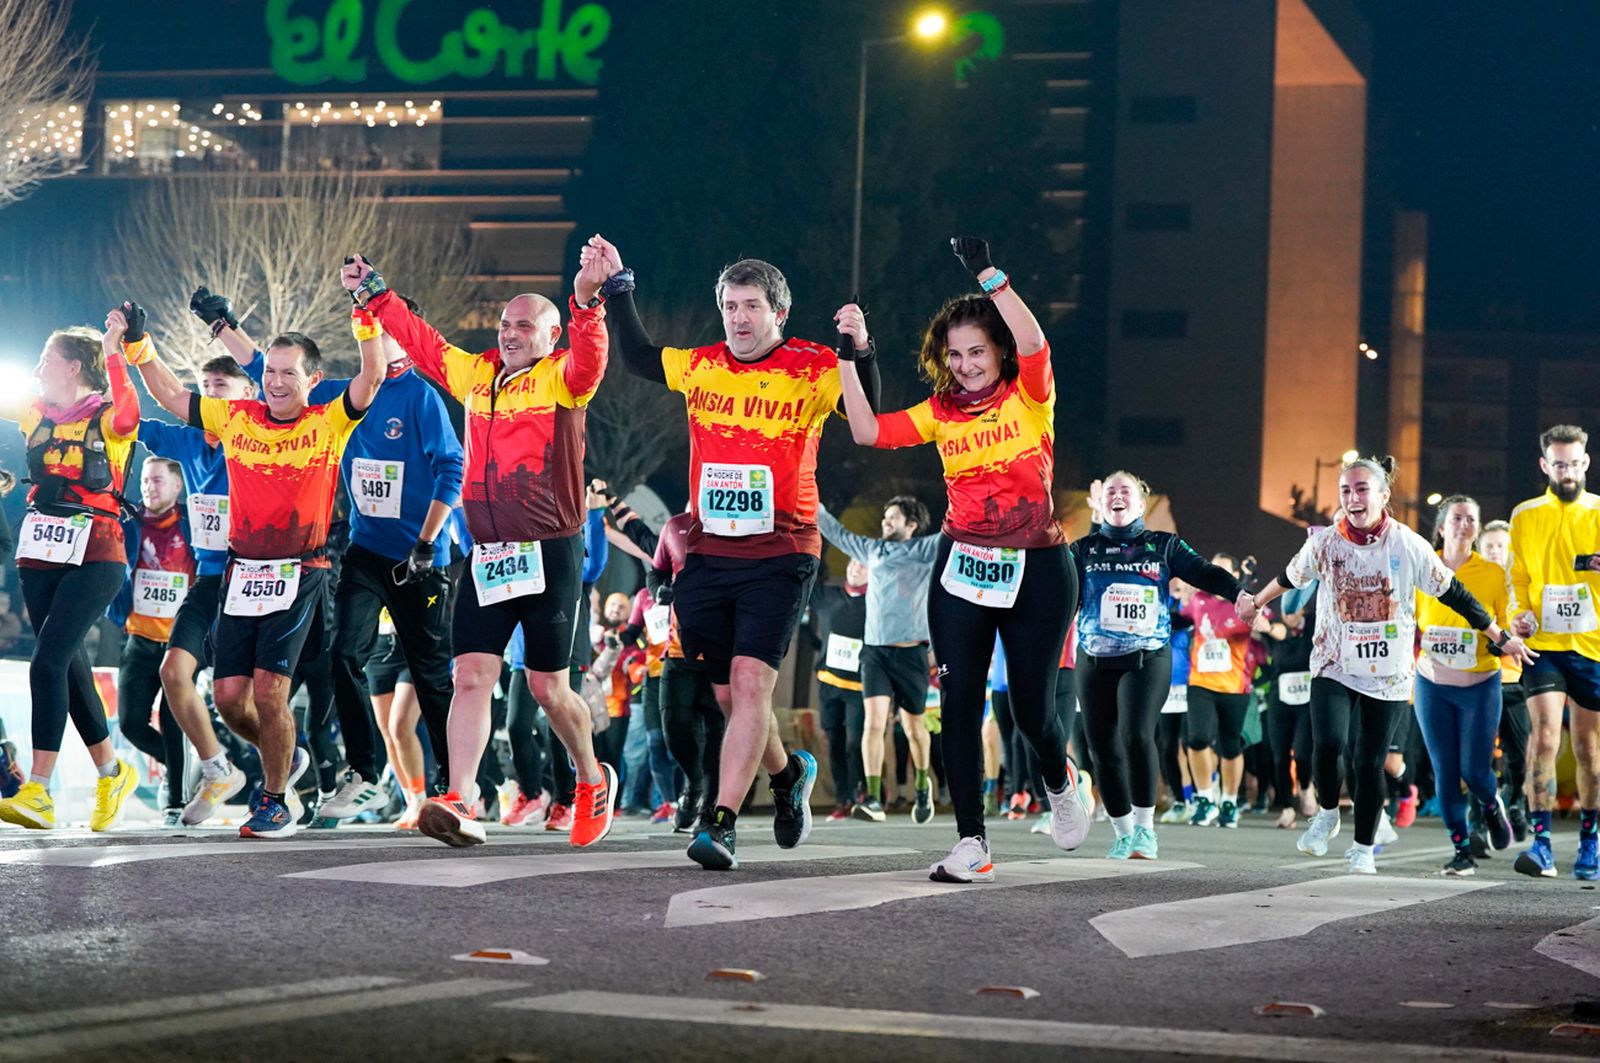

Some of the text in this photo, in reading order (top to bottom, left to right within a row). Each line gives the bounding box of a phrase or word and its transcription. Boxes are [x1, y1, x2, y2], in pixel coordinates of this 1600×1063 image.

[265, 0, 612, 86] El Corte
[744, 396, 805, 424] VIVA!
[973, 420, 1020, 449] VIVA!
[734, 472, 742, 480] DE
[361, 479, 391, 498] 6487
[707, 489, 763, 512] 12298
[33, 524, 75, 544] 5491
[959, 543, 971, 555] SAN
[485, 554, 529, 581] 2434
[958, 554, 1015, 584] 13930
[1085, 562, 1111, 573] SAN
[1115, 560, 1160, 574] ANTÓN
[143, 586, 177, 602] 2485
[241, 579, 286, 597] 4550
[1115, 603, 1147, 620] 1183
[1556, 602, 1581, 617] 452
[1355, 640, 1389, 658] 1173
[1431, 642, 1466, 655] 4834
